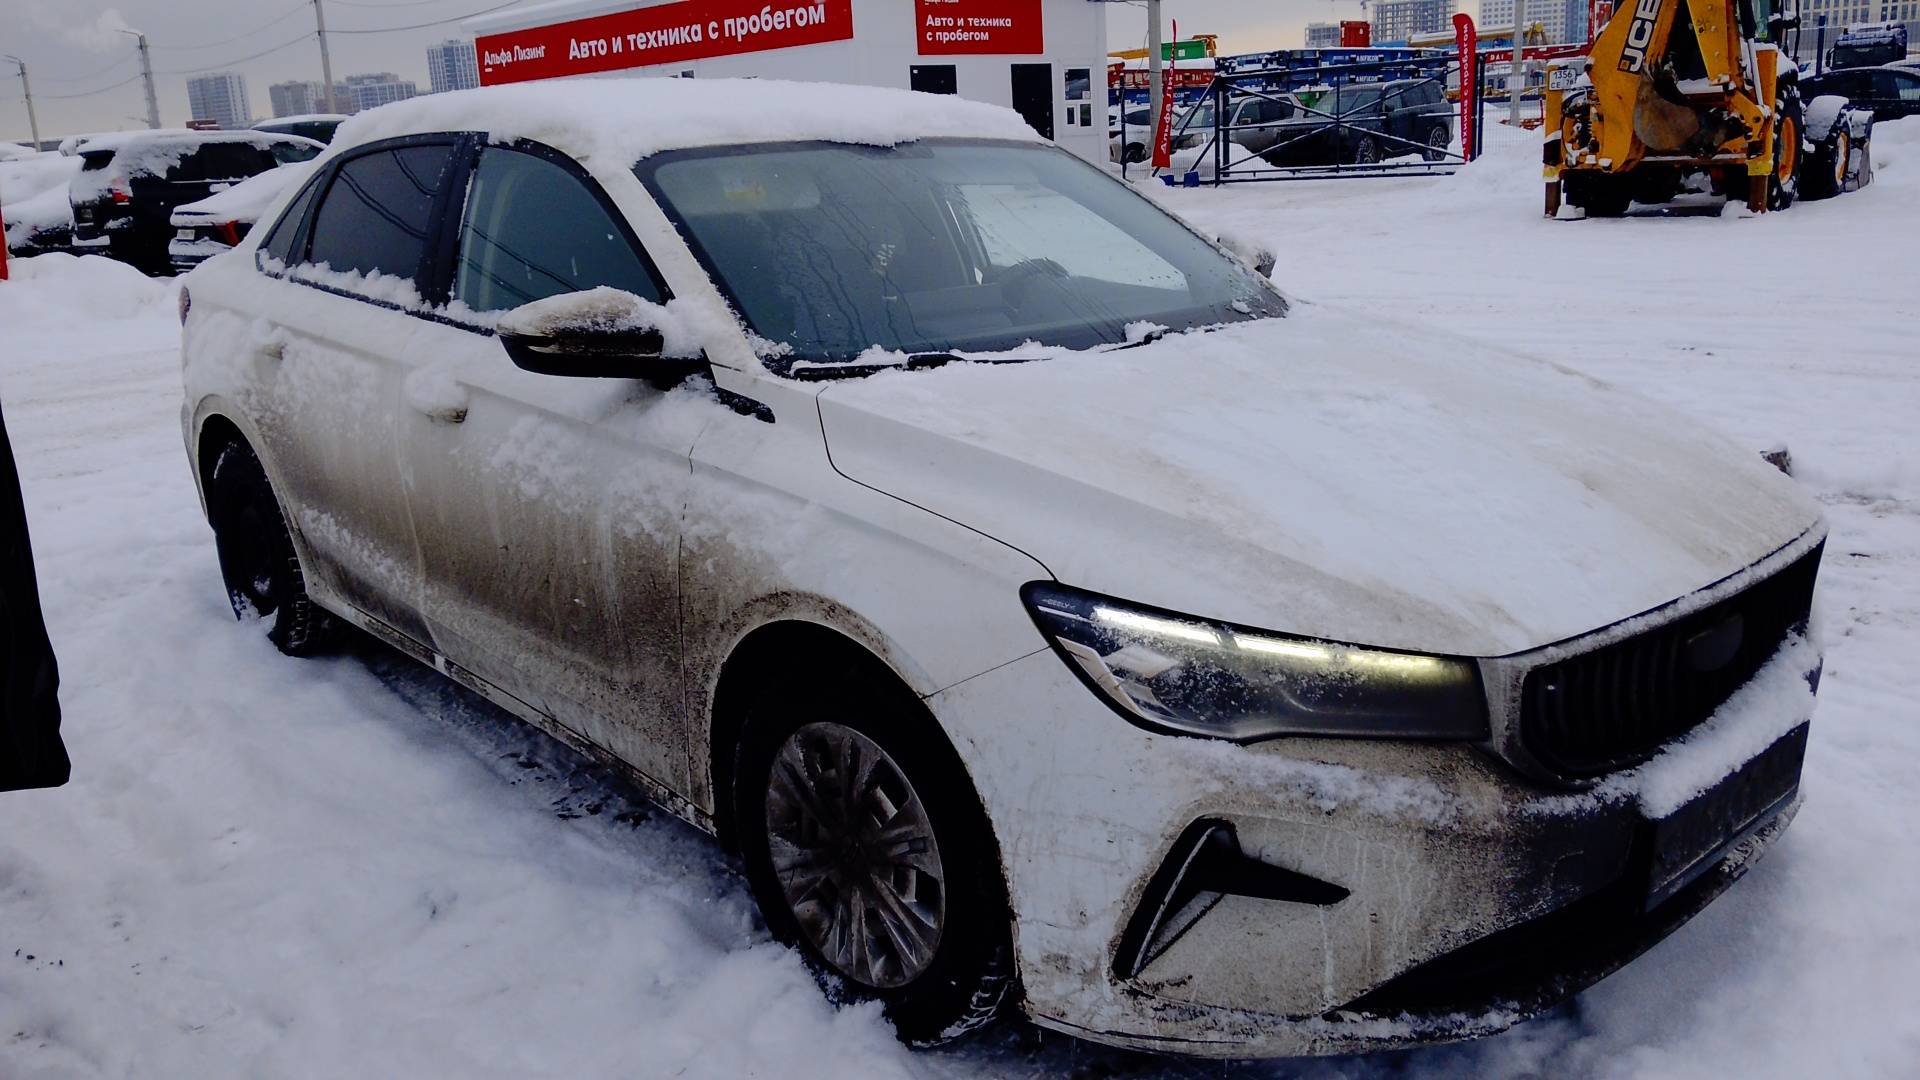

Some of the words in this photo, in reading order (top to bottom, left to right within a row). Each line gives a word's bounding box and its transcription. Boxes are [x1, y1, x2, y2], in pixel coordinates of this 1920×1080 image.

[926, 14, 954, 26] Авто
[957, 17, 964, 26] и
[967, 17, 1012, 26] техника
[569, 38, 607, 61] Авто
[612, 36, 622, 53] и
[627, 23, 702, 51] техника
[708, 21, 719, 39] с
[724, 3, 825, 42] пробегом
[926, 31, 933, 40] с
[936, 29, 989, 44] пробегом
[484, 48, 512, 67] Альфа
[513, 45, 546, 62] Лизинг
[1161, 103, 1171, 155] Альфа
